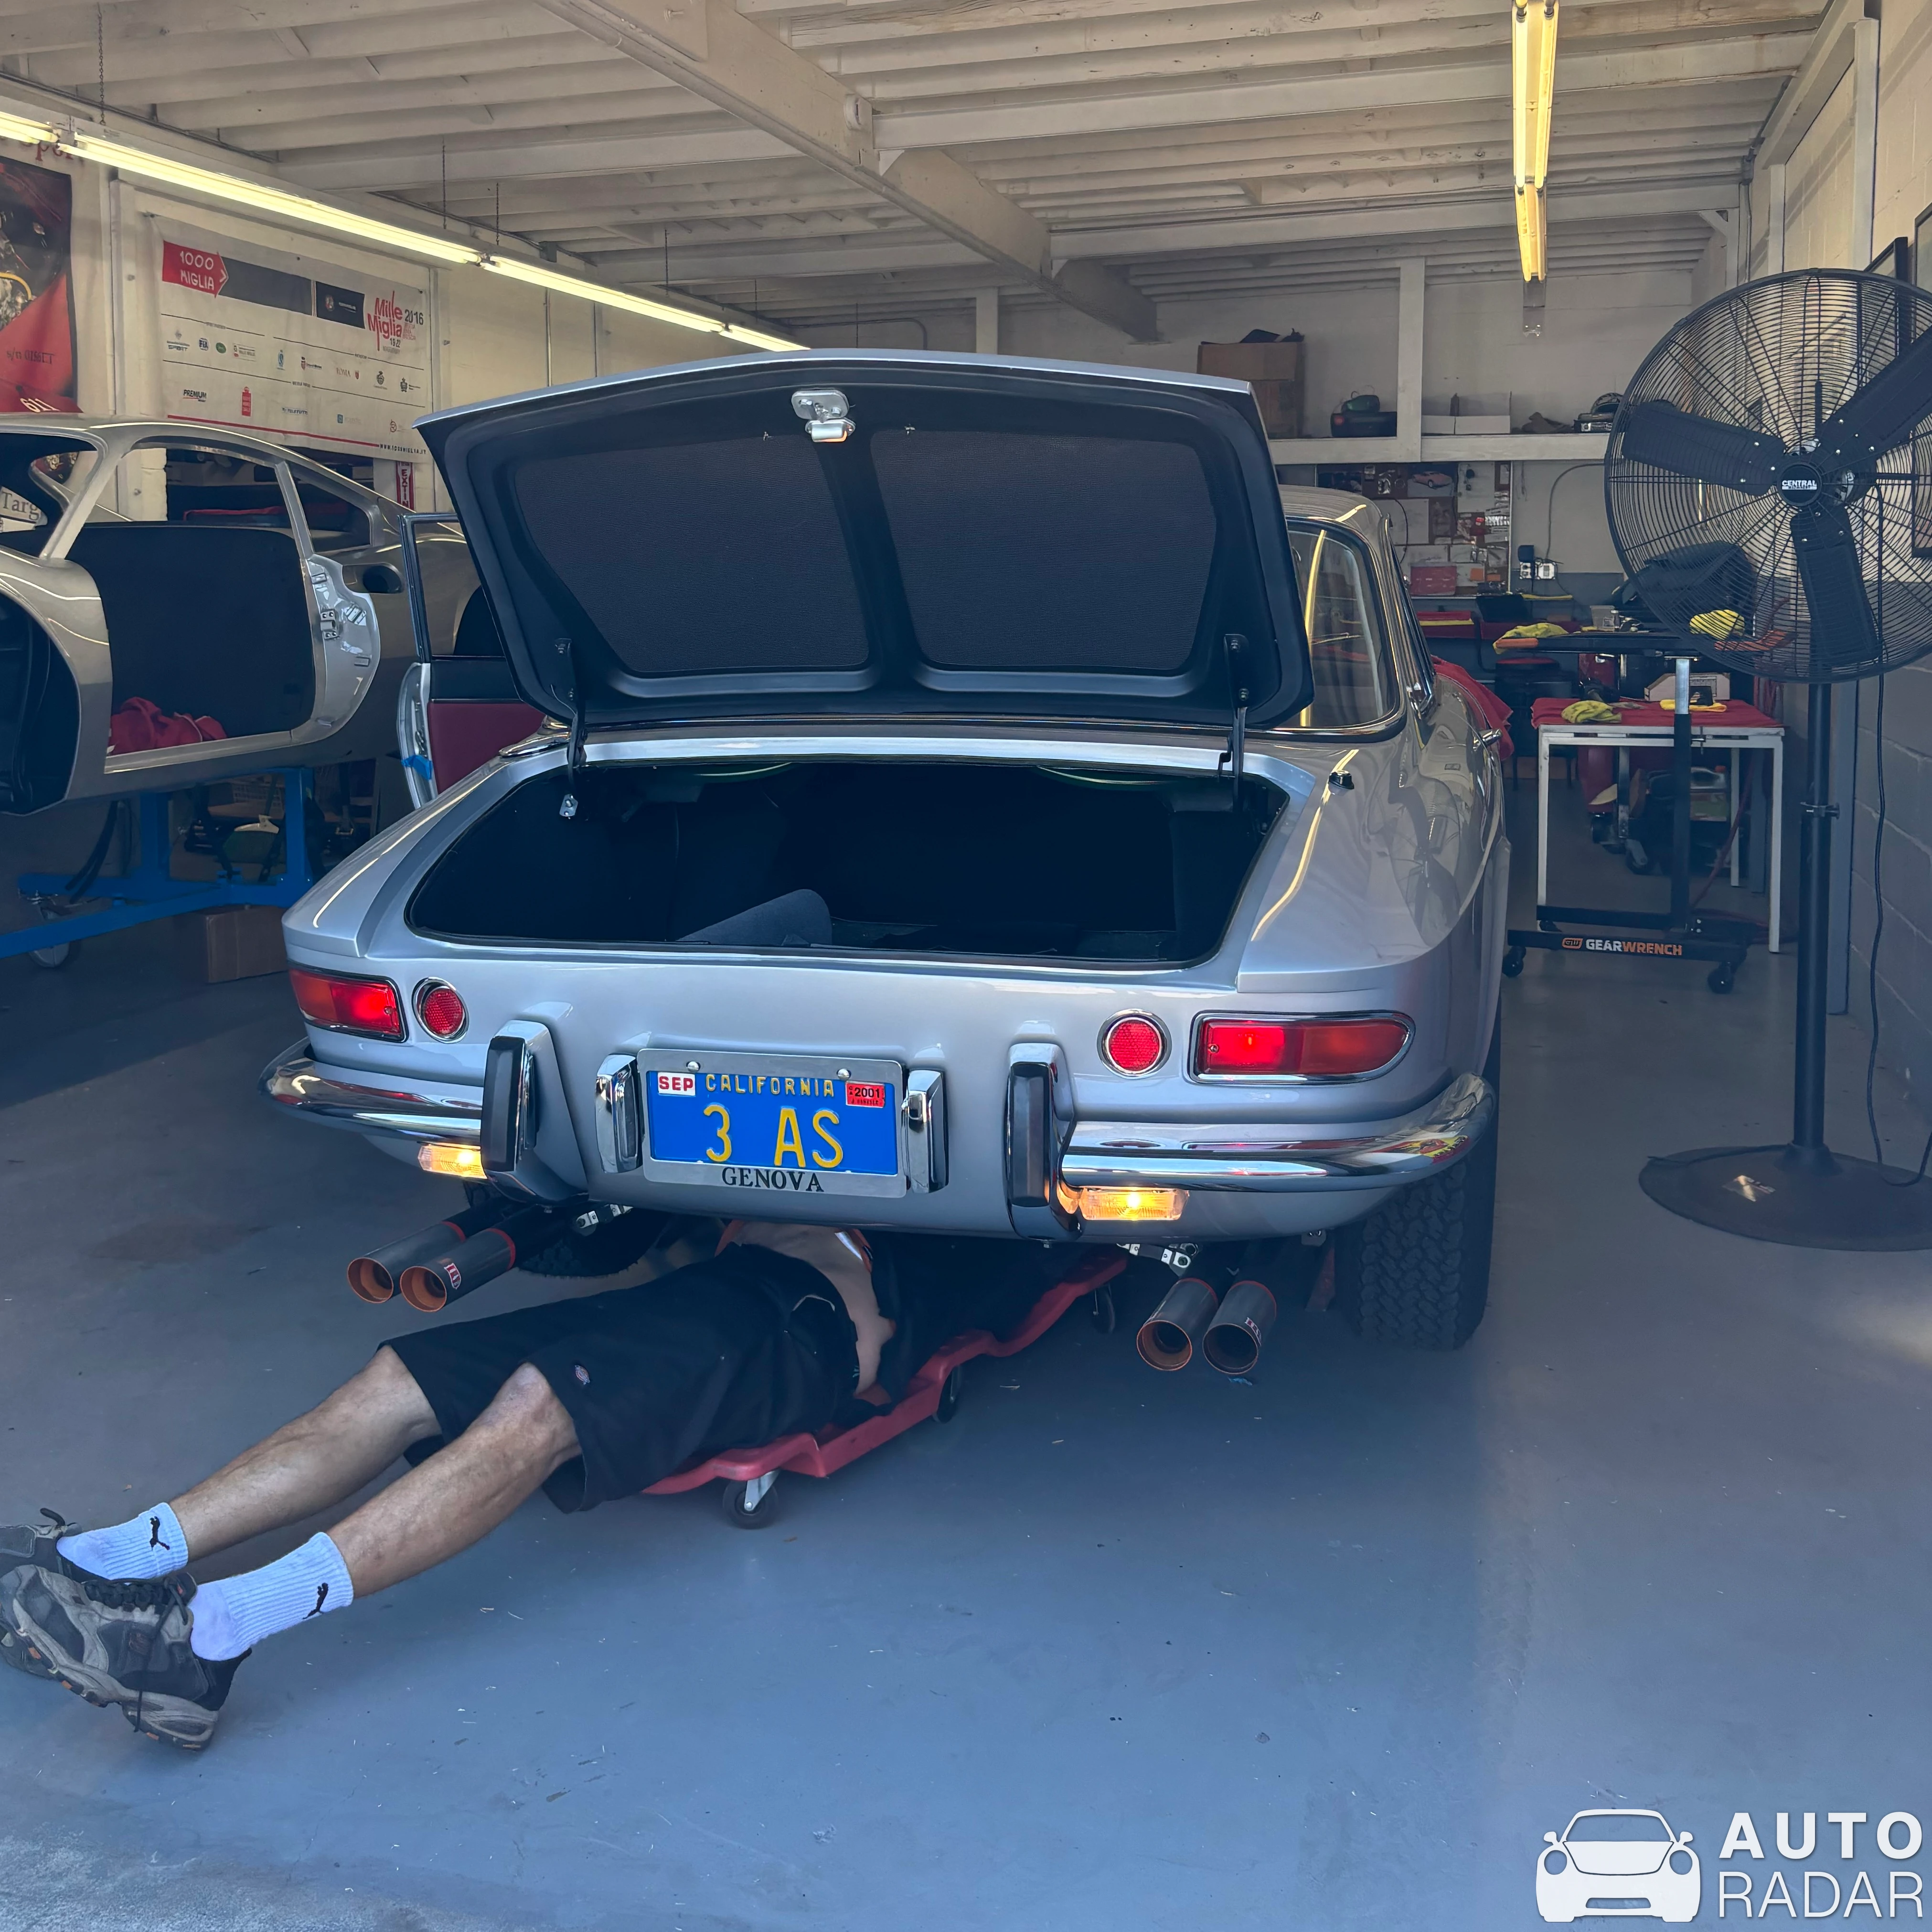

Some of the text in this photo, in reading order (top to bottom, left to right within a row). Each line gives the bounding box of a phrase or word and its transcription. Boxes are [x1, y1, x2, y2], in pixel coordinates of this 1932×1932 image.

[180, 250, 214, 270] 1000
[181, 269, 214, 291] MIGLIA
[374, 290, 403, 320] Mille
[405, 309, 424, 325] 2016
[367, 313, 402, 352] Miglia
[183, 389, 207, 399] PREMIUM
[20, 398, 61, 413] 611
[1586, 939, 1683, 956] GEARWRENCH
[659, 1076, 694, 1092] SEP
[705, 1074, 834, 1097] CALIFORNIA
[854, 1087, 880, 1099] 2001
[703, 1104, 843, 1168] 3 AS
[722, 1166, 824, 1193] GENOVA
